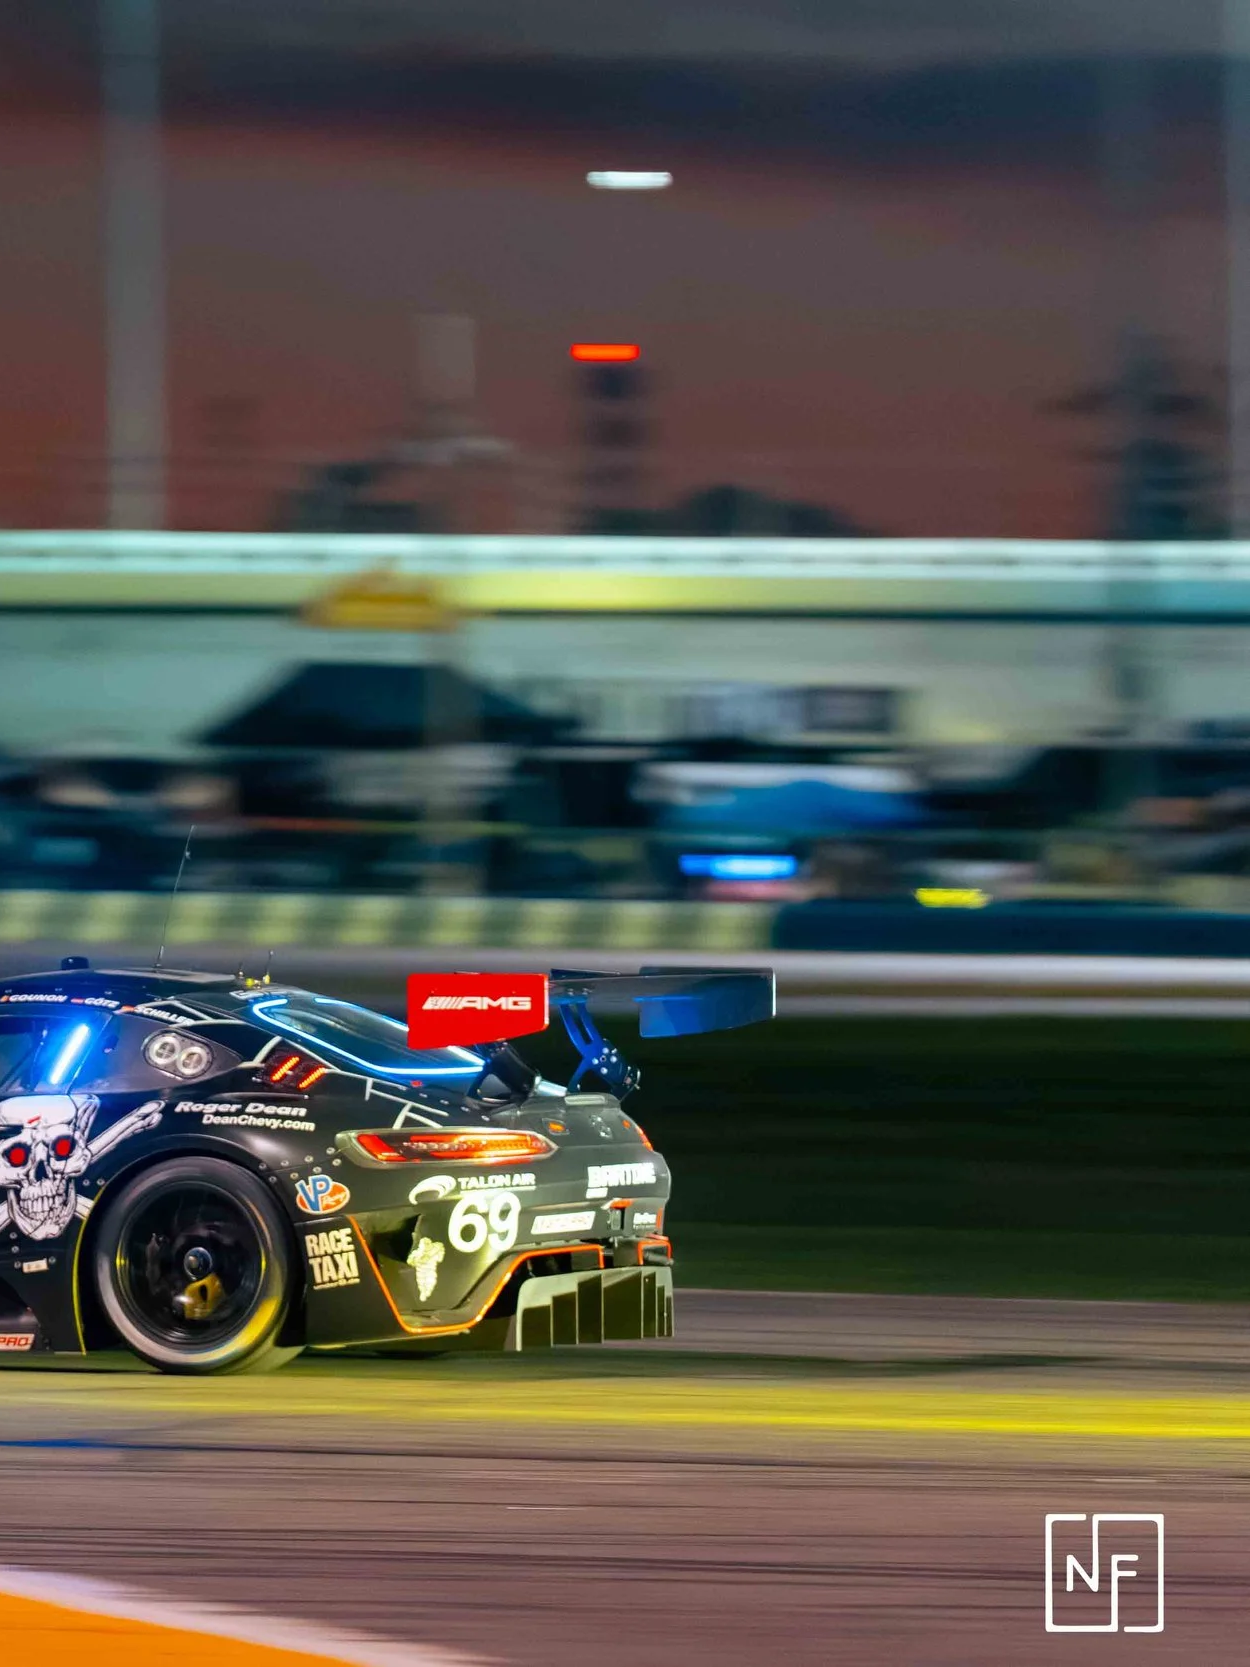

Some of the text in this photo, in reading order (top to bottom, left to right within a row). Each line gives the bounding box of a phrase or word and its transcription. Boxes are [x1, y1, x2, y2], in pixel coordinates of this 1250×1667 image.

[9, 994, 68, 1003] GOUNON
[459, 996, 532, 1011] AMG
[174, 1101, 308, 1117] Roger Dean
[202, 1114, 316, 1132] DeanChevy.com
[458, 1173, 536, 1189] TALON AIR
[295, 1174, 333, 1213] VP
[448, 1191, 520, 1253] 69
[305, 1228, 355, 1257] RACE
[309, 1251, 359, 1284] TAXI
